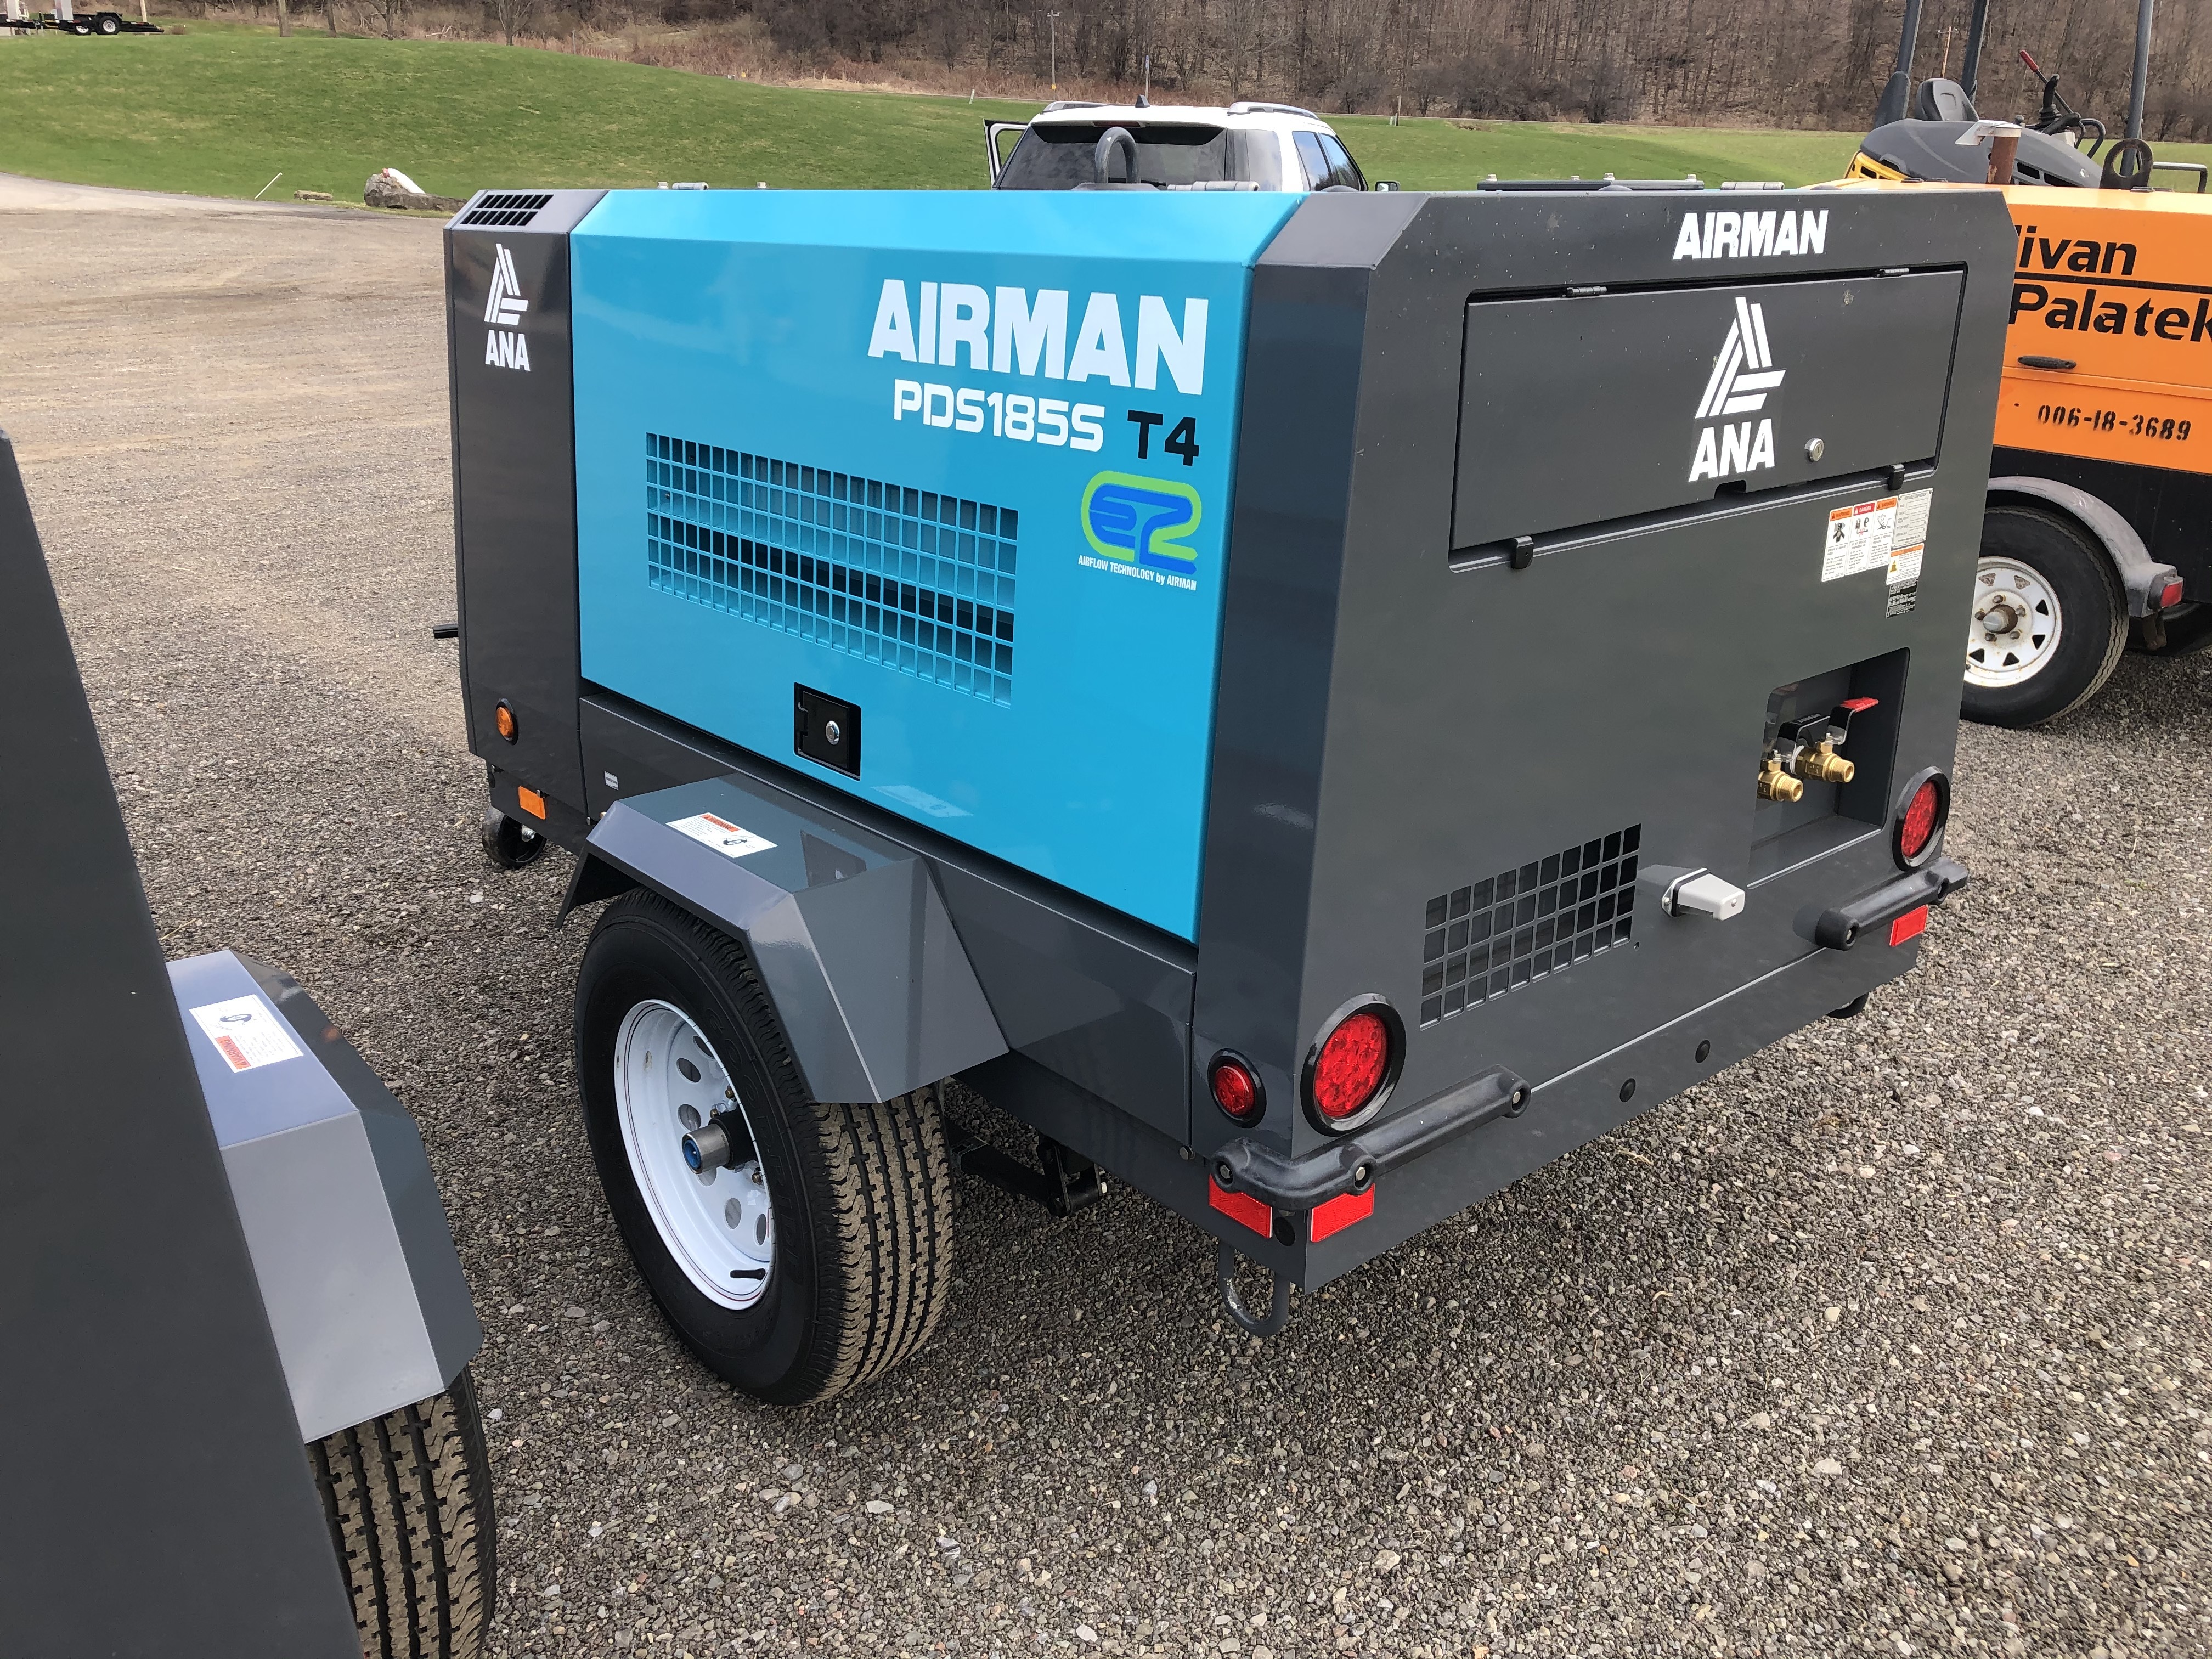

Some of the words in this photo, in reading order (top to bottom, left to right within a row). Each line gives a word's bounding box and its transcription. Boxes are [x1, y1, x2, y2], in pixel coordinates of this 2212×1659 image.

[1672, 209, 1829, 261] AIRMAN
[485, 329, 531, 371] ANA
[867, 278, 1209, 396] AIRMAN
[893, 379, 1105, 453] PDS185S
[1127, 409, 1200, 467] T4
[2038, 404, 2192, 441] 006-18-3689
[1688, 418, 1775, 482] ANA
[1078, 555, 1108, 571] AIRFLOW
[1109, 562, 1155, 582] TECHNOLOGY
[1156, 572, 1165, 585] by
[1166, 575, 1197, 591] AIRMAN
[219, 1039, 244, 1063] WARNING
